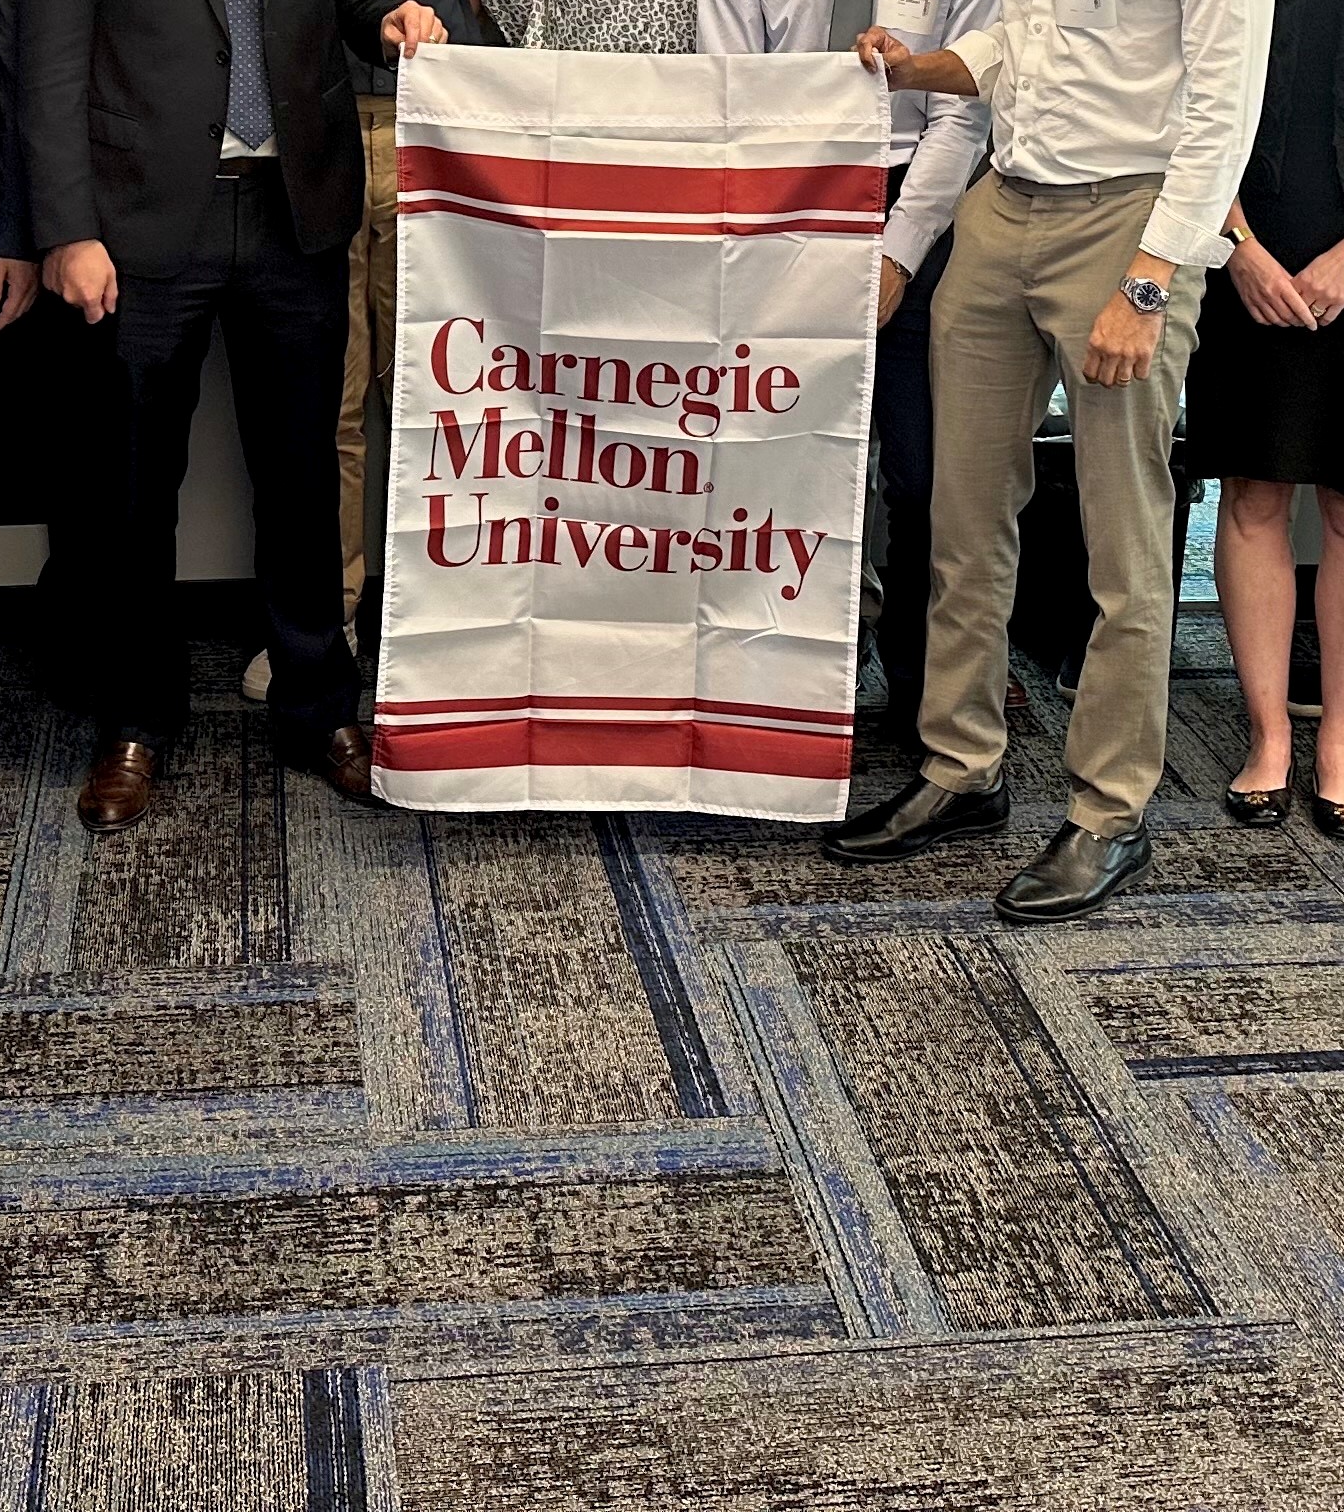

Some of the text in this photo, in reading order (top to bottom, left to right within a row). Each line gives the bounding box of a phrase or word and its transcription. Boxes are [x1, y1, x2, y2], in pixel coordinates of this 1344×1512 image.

[430, 316, 801, 439] Carnegie
[422, 405, 705, 496] Mellon
[422, 491, 828, 601] University
